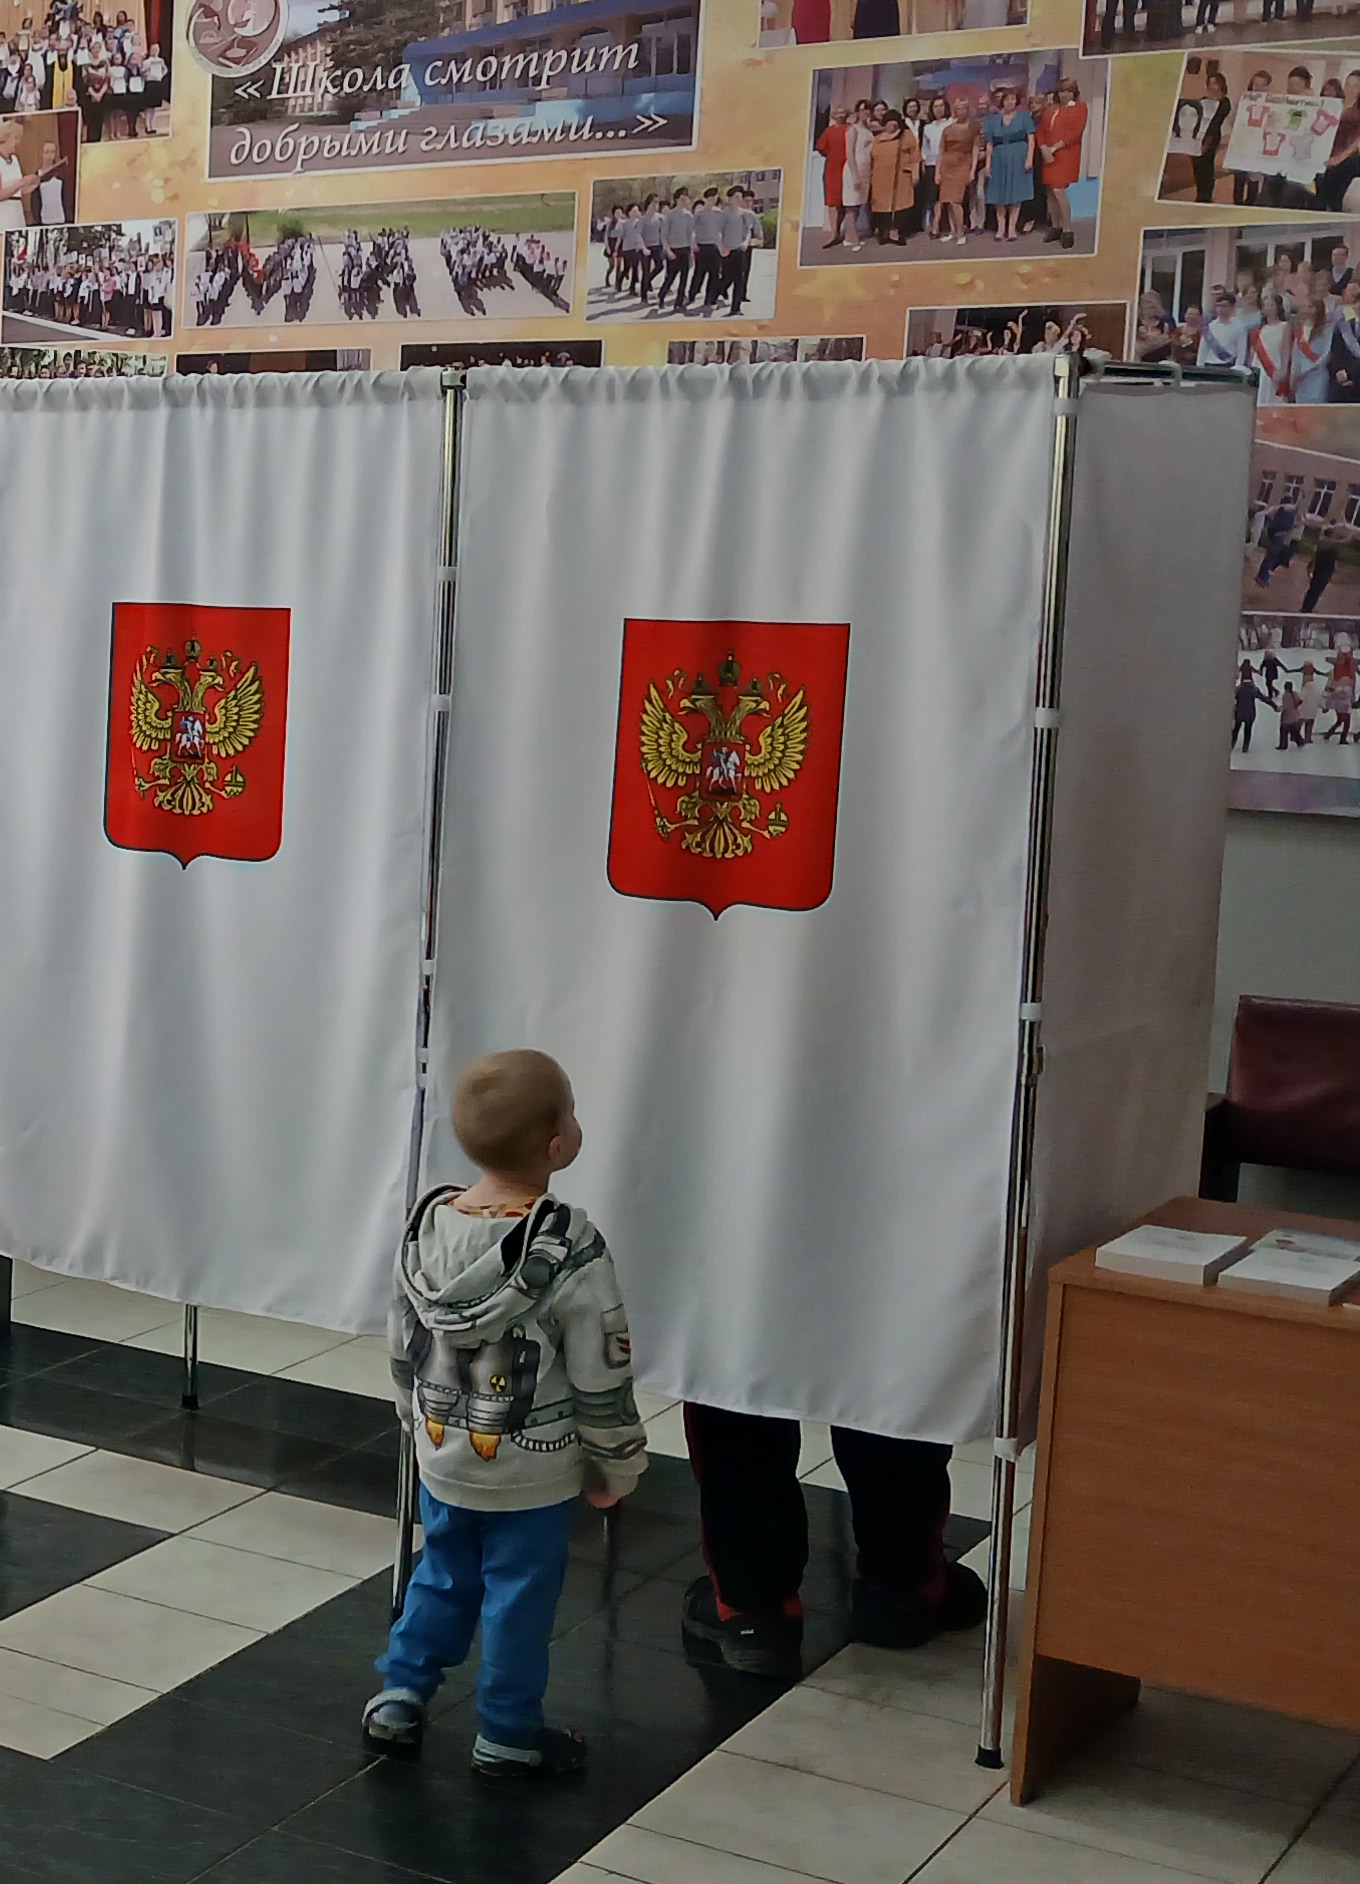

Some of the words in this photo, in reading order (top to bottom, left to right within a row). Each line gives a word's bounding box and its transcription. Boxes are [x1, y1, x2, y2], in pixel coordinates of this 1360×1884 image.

[234, 61, 411, 100] «Школа
[424, 41, 639, 91] смотрит
[230, 122, 407, 175] добрыми
[420, 113, 668, 151] глазами...»
